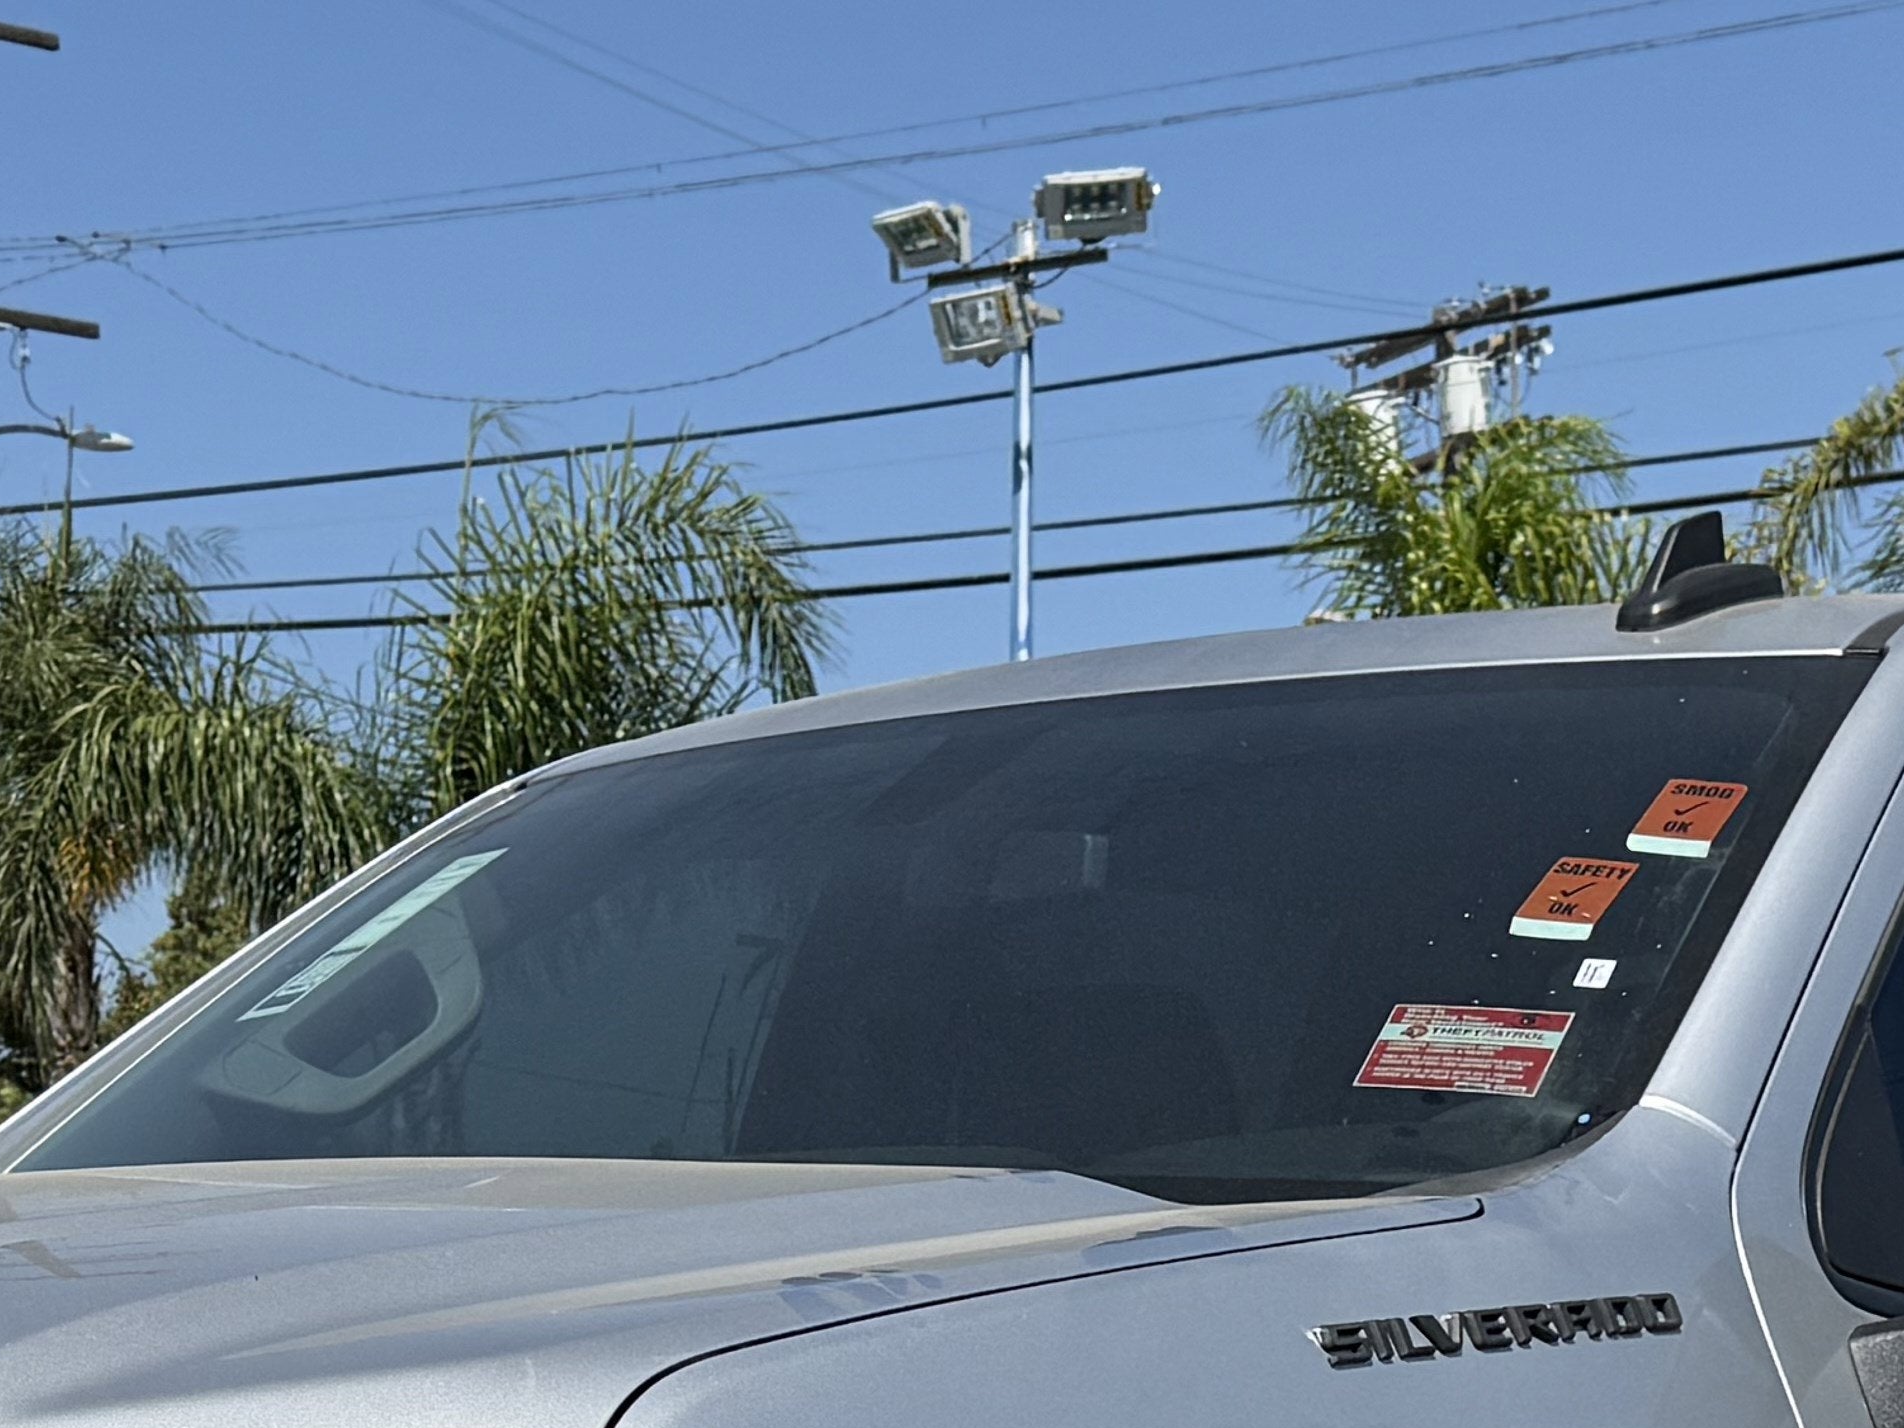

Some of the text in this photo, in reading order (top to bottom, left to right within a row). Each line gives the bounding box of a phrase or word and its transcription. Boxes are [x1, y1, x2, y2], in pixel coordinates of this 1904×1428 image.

[1662, 820, 1694, 834] OK
[1553, 861, 1631, 881] SAFETY
[1547, 901, 1579, 917] OK
[1312, 1292, 1684, 1370] SILVERADO
